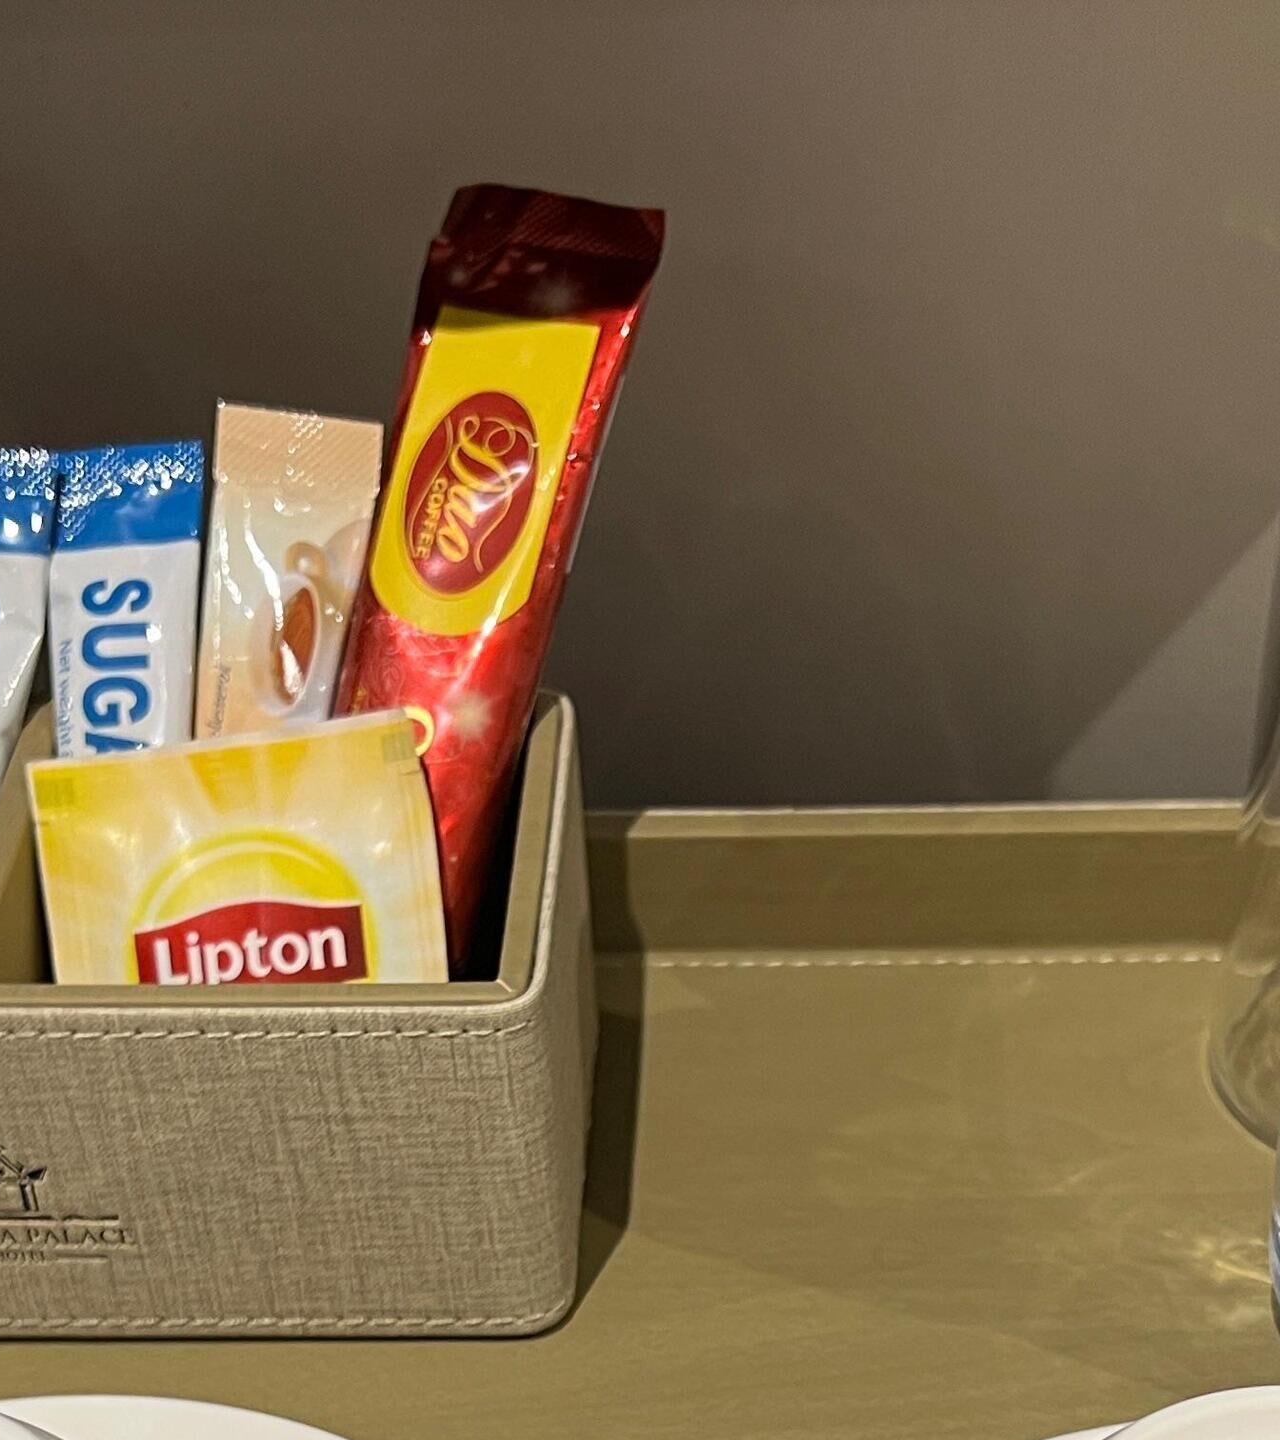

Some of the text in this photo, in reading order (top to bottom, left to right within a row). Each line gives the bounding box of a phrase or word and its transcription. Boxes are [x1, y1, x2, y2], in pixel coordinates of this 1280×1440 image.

[414, 476, 449, 560] COFFEE
[153, 926, 348, 986] Lipton
[26, 1227, 135, 1244] PALACE
